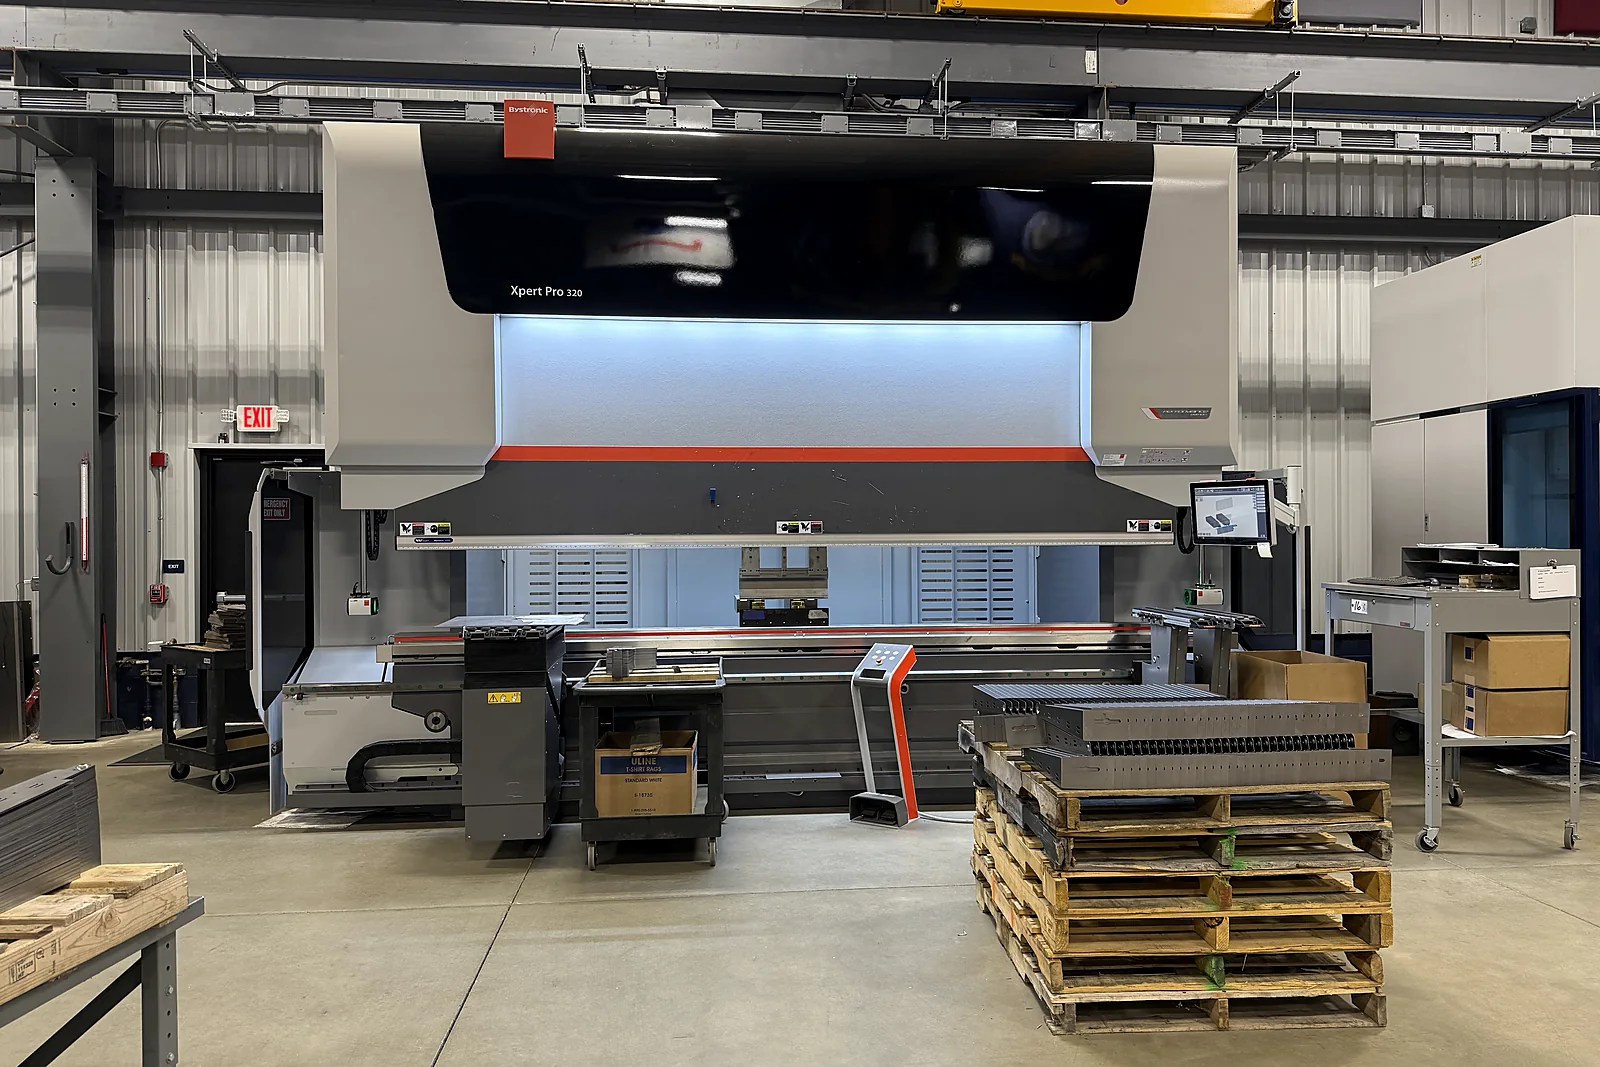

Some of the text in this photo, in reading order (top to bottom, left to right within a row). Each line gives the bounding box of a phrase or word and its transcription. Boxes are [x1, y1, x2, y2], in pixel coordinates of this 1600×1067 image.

[508, 106, 549, 114] Bystronic
[510, 285, 583, 298] Xpert Pro 320
[243, 406, 273, 428] EXIT
[263, 500, 288, 508] MERGENCY
[263, 509, 285, 517] EXIT ONLY
[631, 757, 657, 766] ULINE
